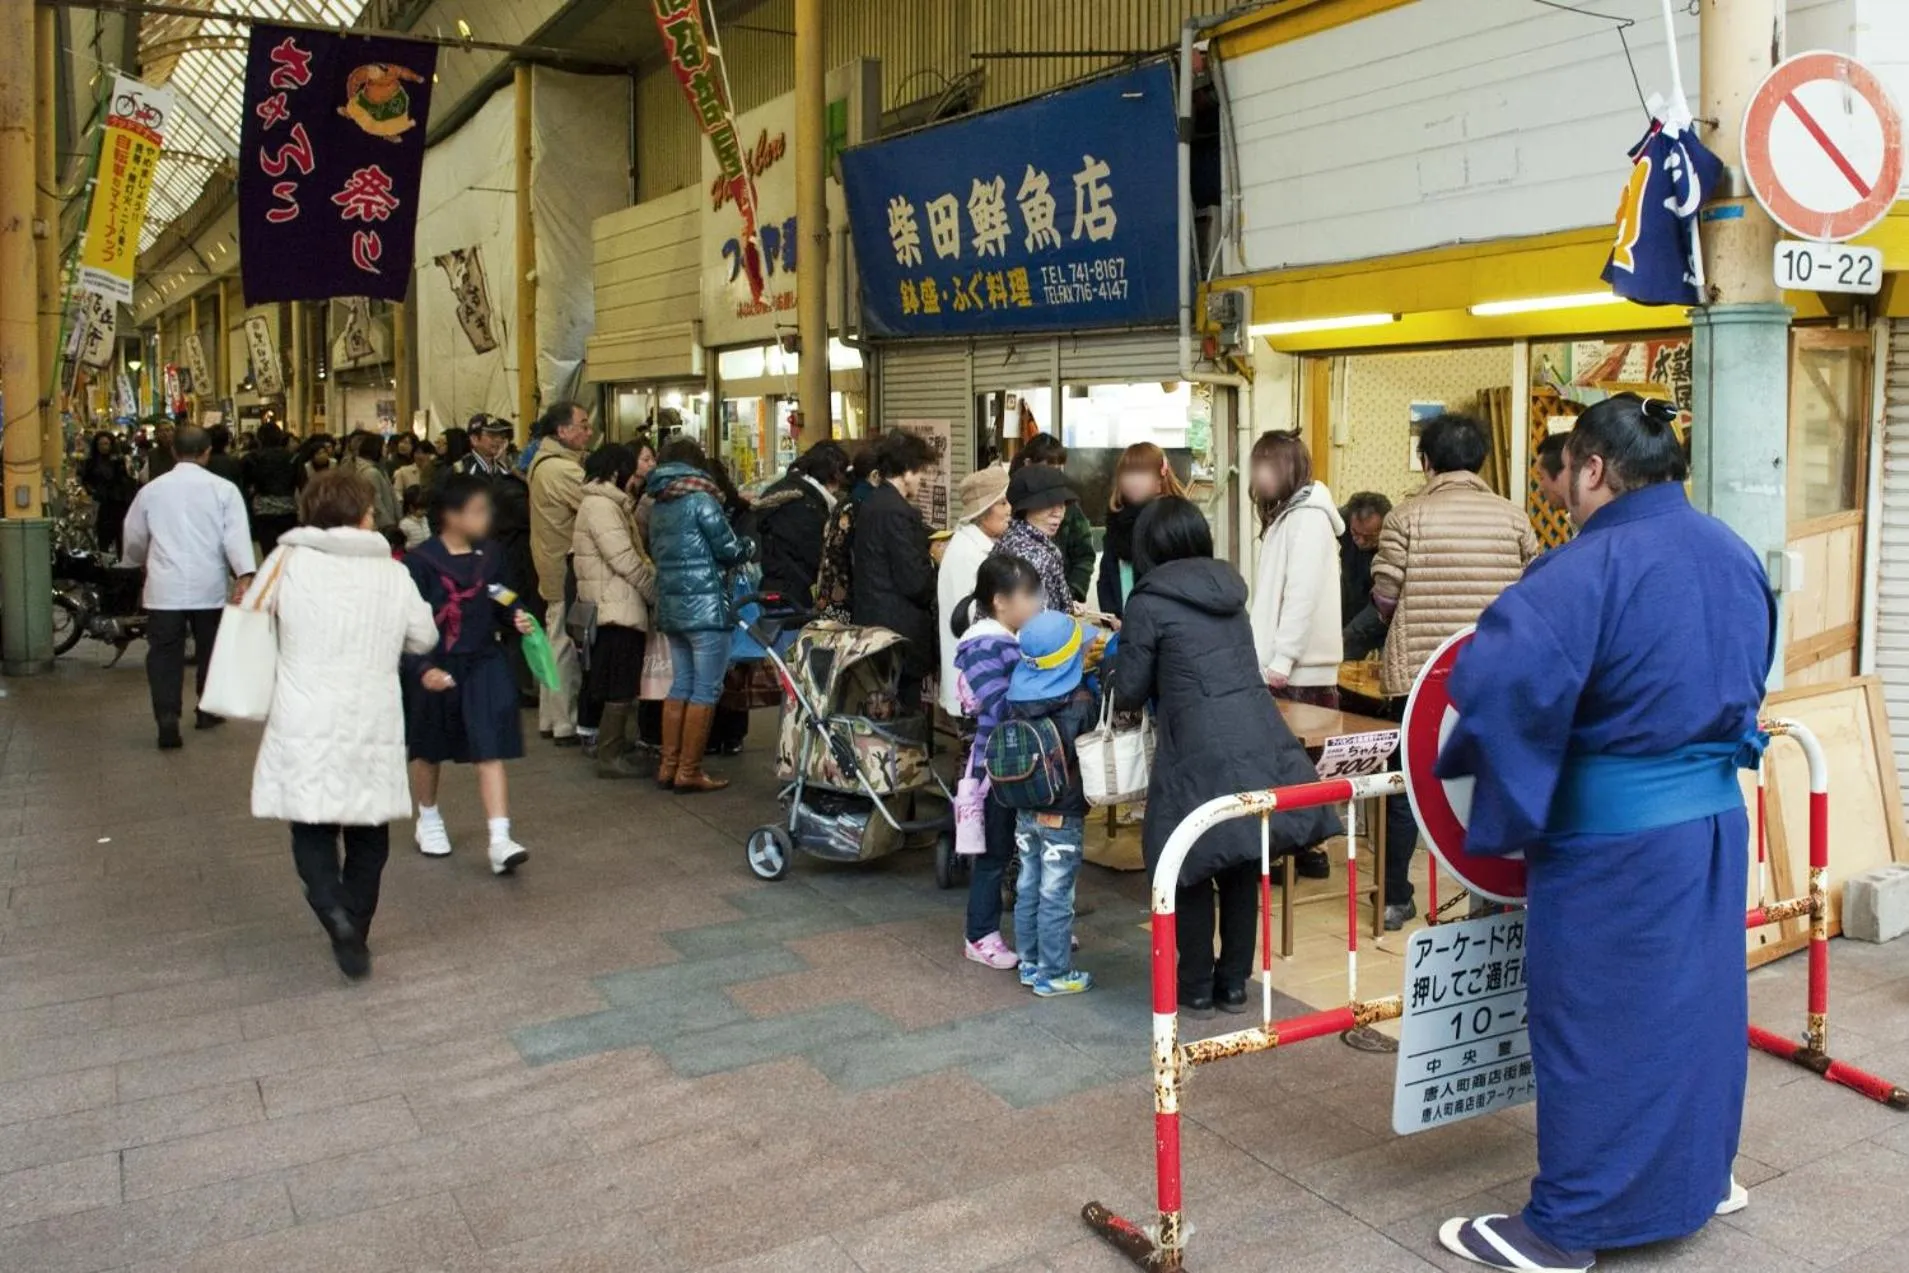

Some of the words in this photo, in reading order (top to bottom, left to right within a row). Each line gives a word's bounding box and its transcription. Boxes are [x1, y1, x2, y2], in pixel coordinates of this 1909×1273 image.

[888, 154, 1117, 268] 柴田鮮魚店
[1041, 265, 1066, 284] TEL
[1068, 257, 1125, 283] 741-8167
[1782, 249, 1873, 286] 10-22
[1415, 921, 1527, 969] アーケード内
[1412, 957, 1527, 1008] 押してご通行
